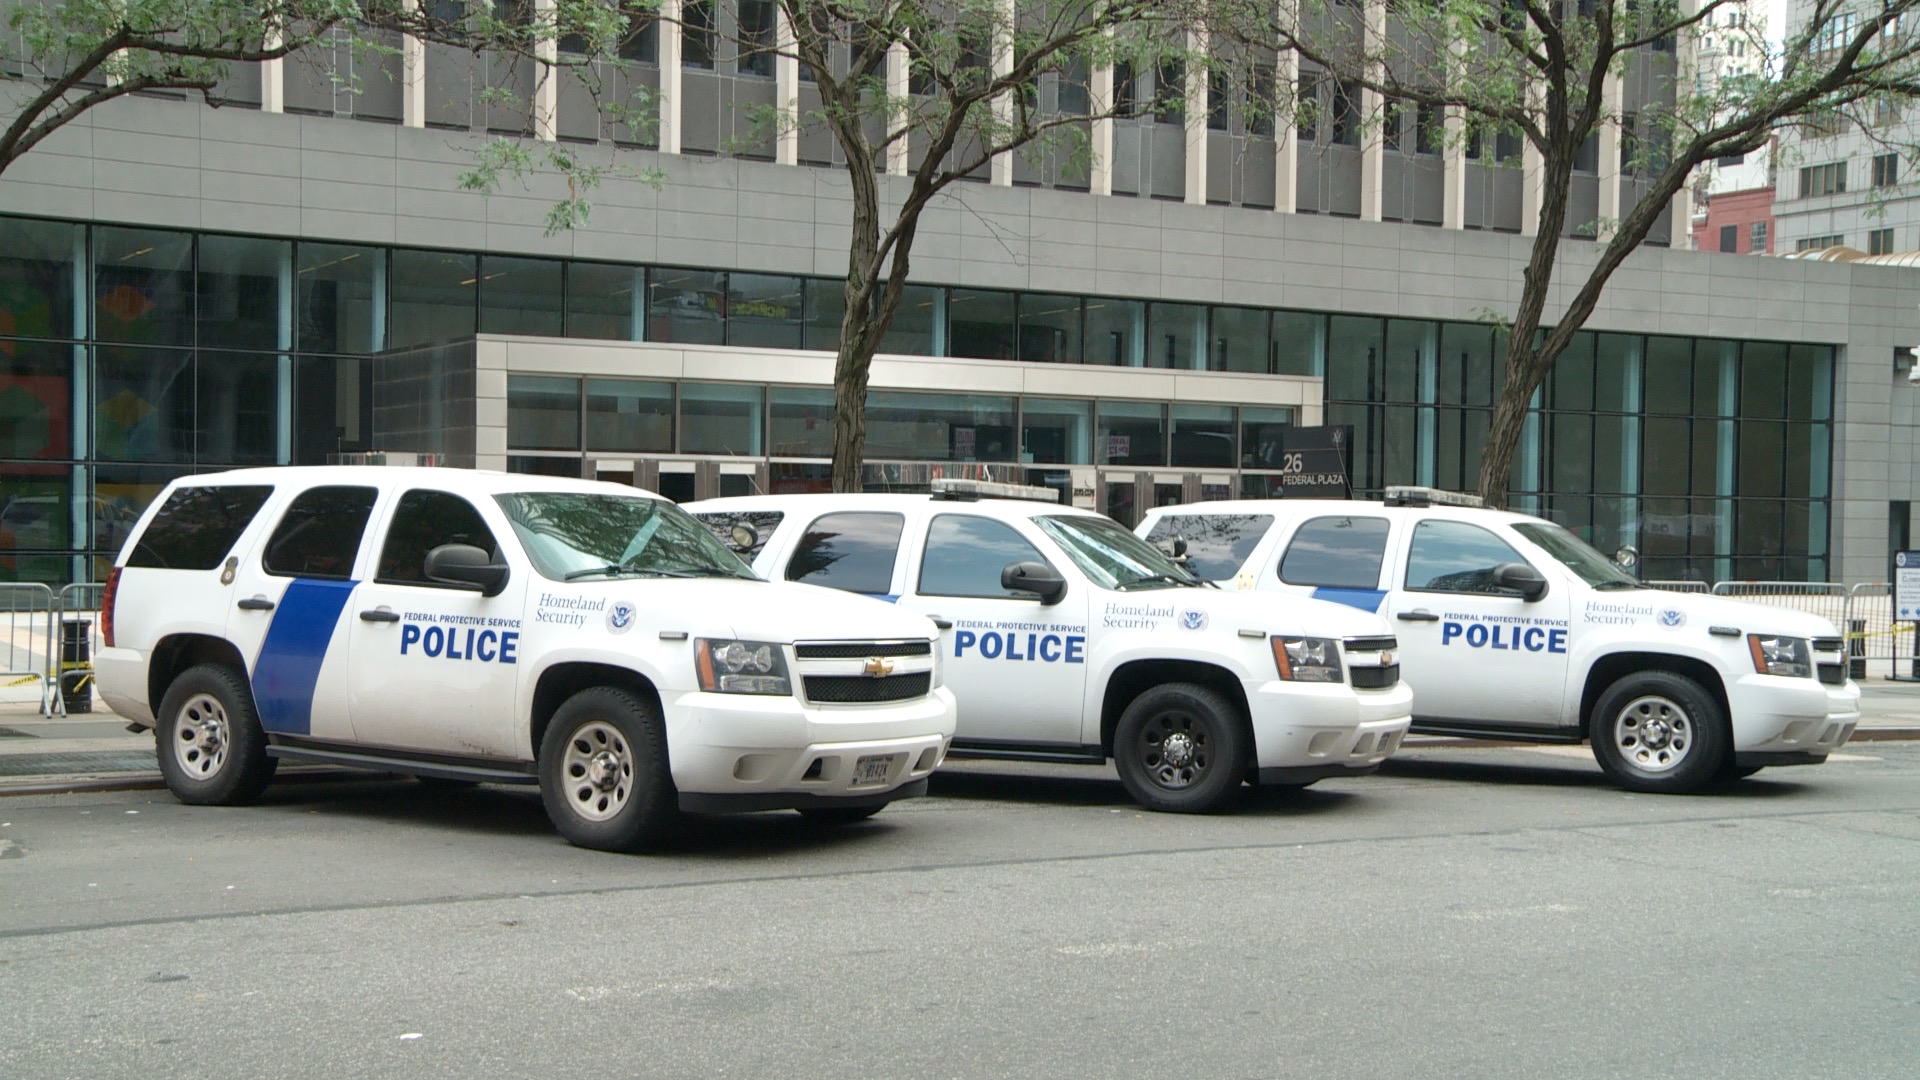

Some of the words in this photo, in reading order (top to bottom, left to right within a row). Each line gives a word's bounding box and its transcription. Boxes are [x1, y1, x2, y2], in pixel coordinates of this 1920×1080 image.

[1283, 453, 1303, 473] 26
[1283, 475, 1316, 485] FEDERAL
[1318, 474, 1344, 485] PLAZA
[538, 593, 606, 612] Homeland
[1104, 602, 1175, 618] Homeland
[1585, 600, 1653, 616] Homeland
[403, 612, 437, 623] FEDERAL
[439, 614, 486, 626] PROTECTIVE
[488, 617, 521, 628] SERVICE
[535, 608, 588, 630] Security
[956, 620, 994, 630] FEDERAL
[996, 622, 1048, 632] PROTECTIVE
[1050, 624, 1087, 633] SERVICE
[1102, 614, 1159, 632] Security
[1444, 612, 1480, 621] FEDERAL
[1482, 615, 1532, 625] PROTECTIVE
[1534, 617, 1569, 627] SERVICE
[1583, 611, 1638, 628] Security
[400, 624, 520, 664] POLICE
[1442, 621, 1568, 654] POLICE
[954, 630, 1086, 663] POLICE
